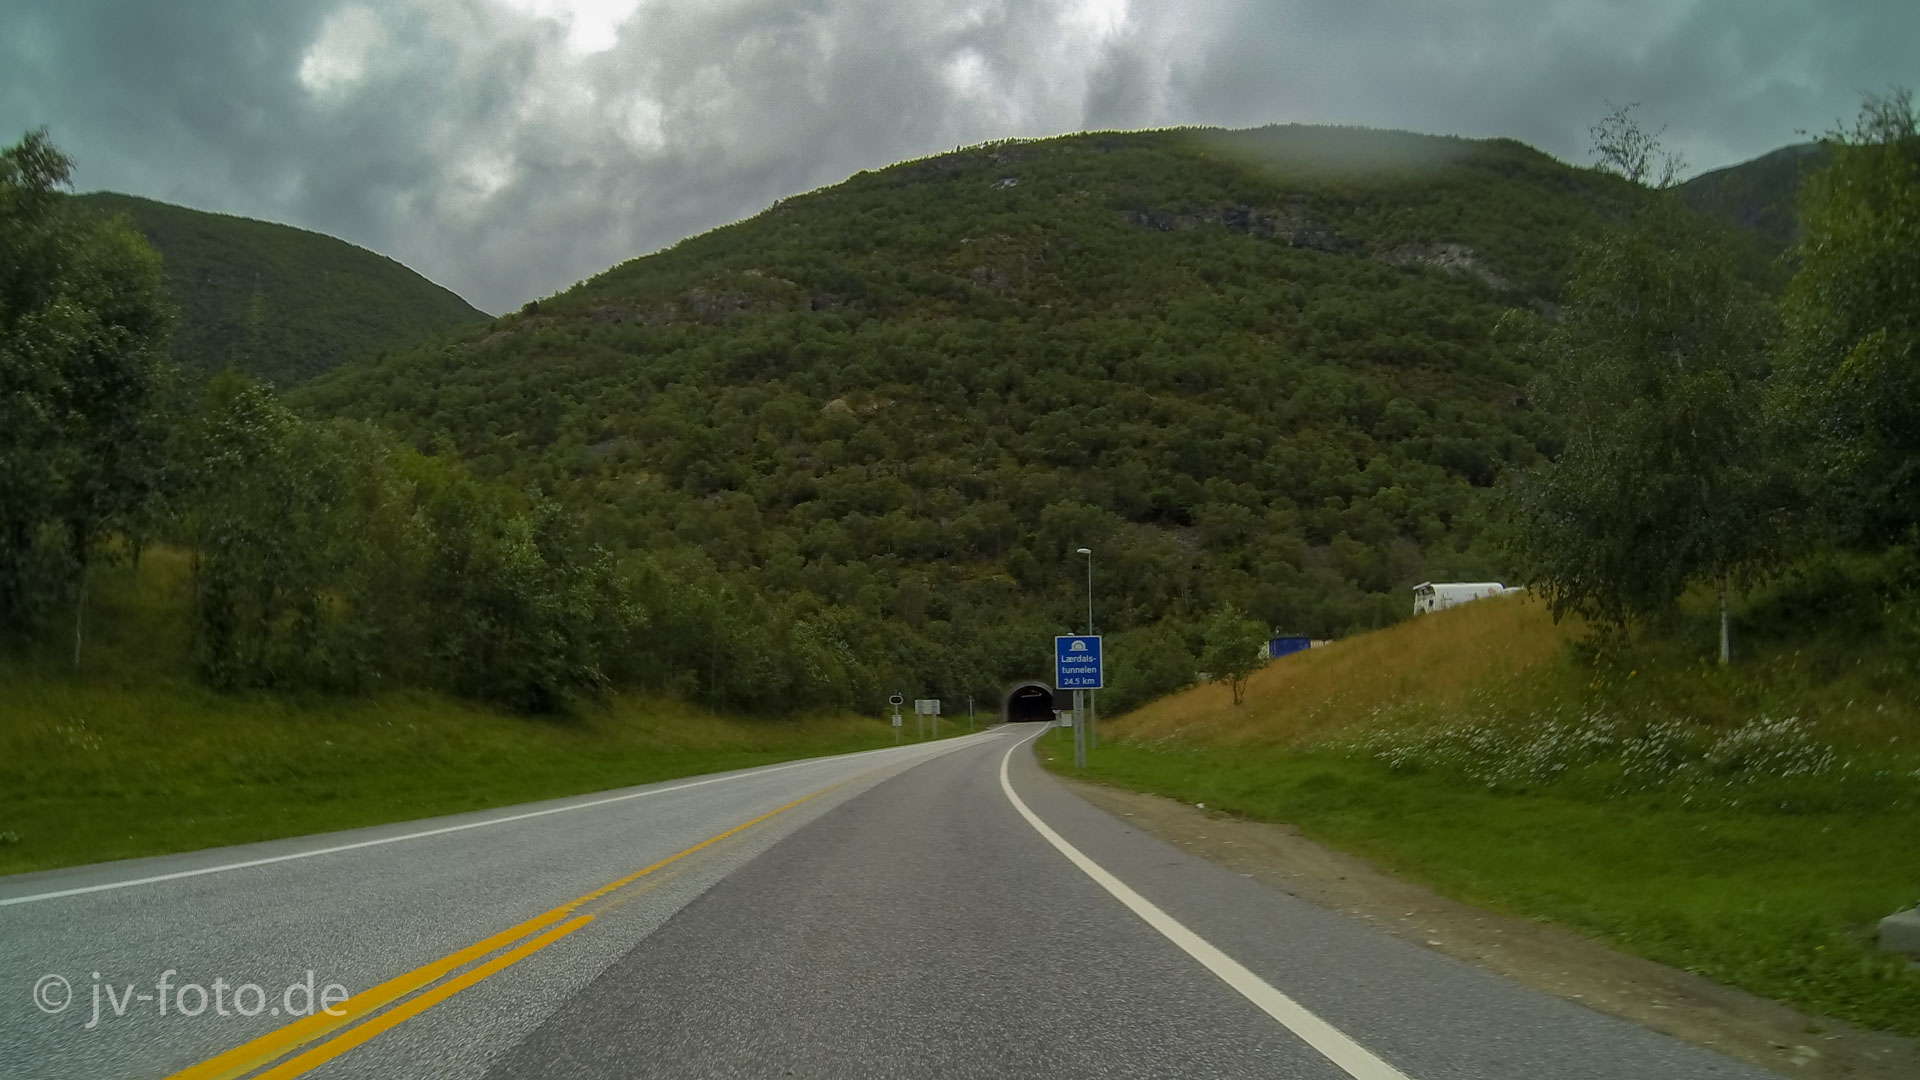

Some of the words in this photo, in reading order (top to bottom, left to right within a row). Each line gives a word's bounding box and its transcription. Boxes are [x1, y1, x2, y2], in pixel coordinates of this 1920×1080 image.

[1061, 655, 1096, 663] Lærdals-
[1062, 666, 1097, 674] tunnelen
[1082, 677, 1095, 685] km
